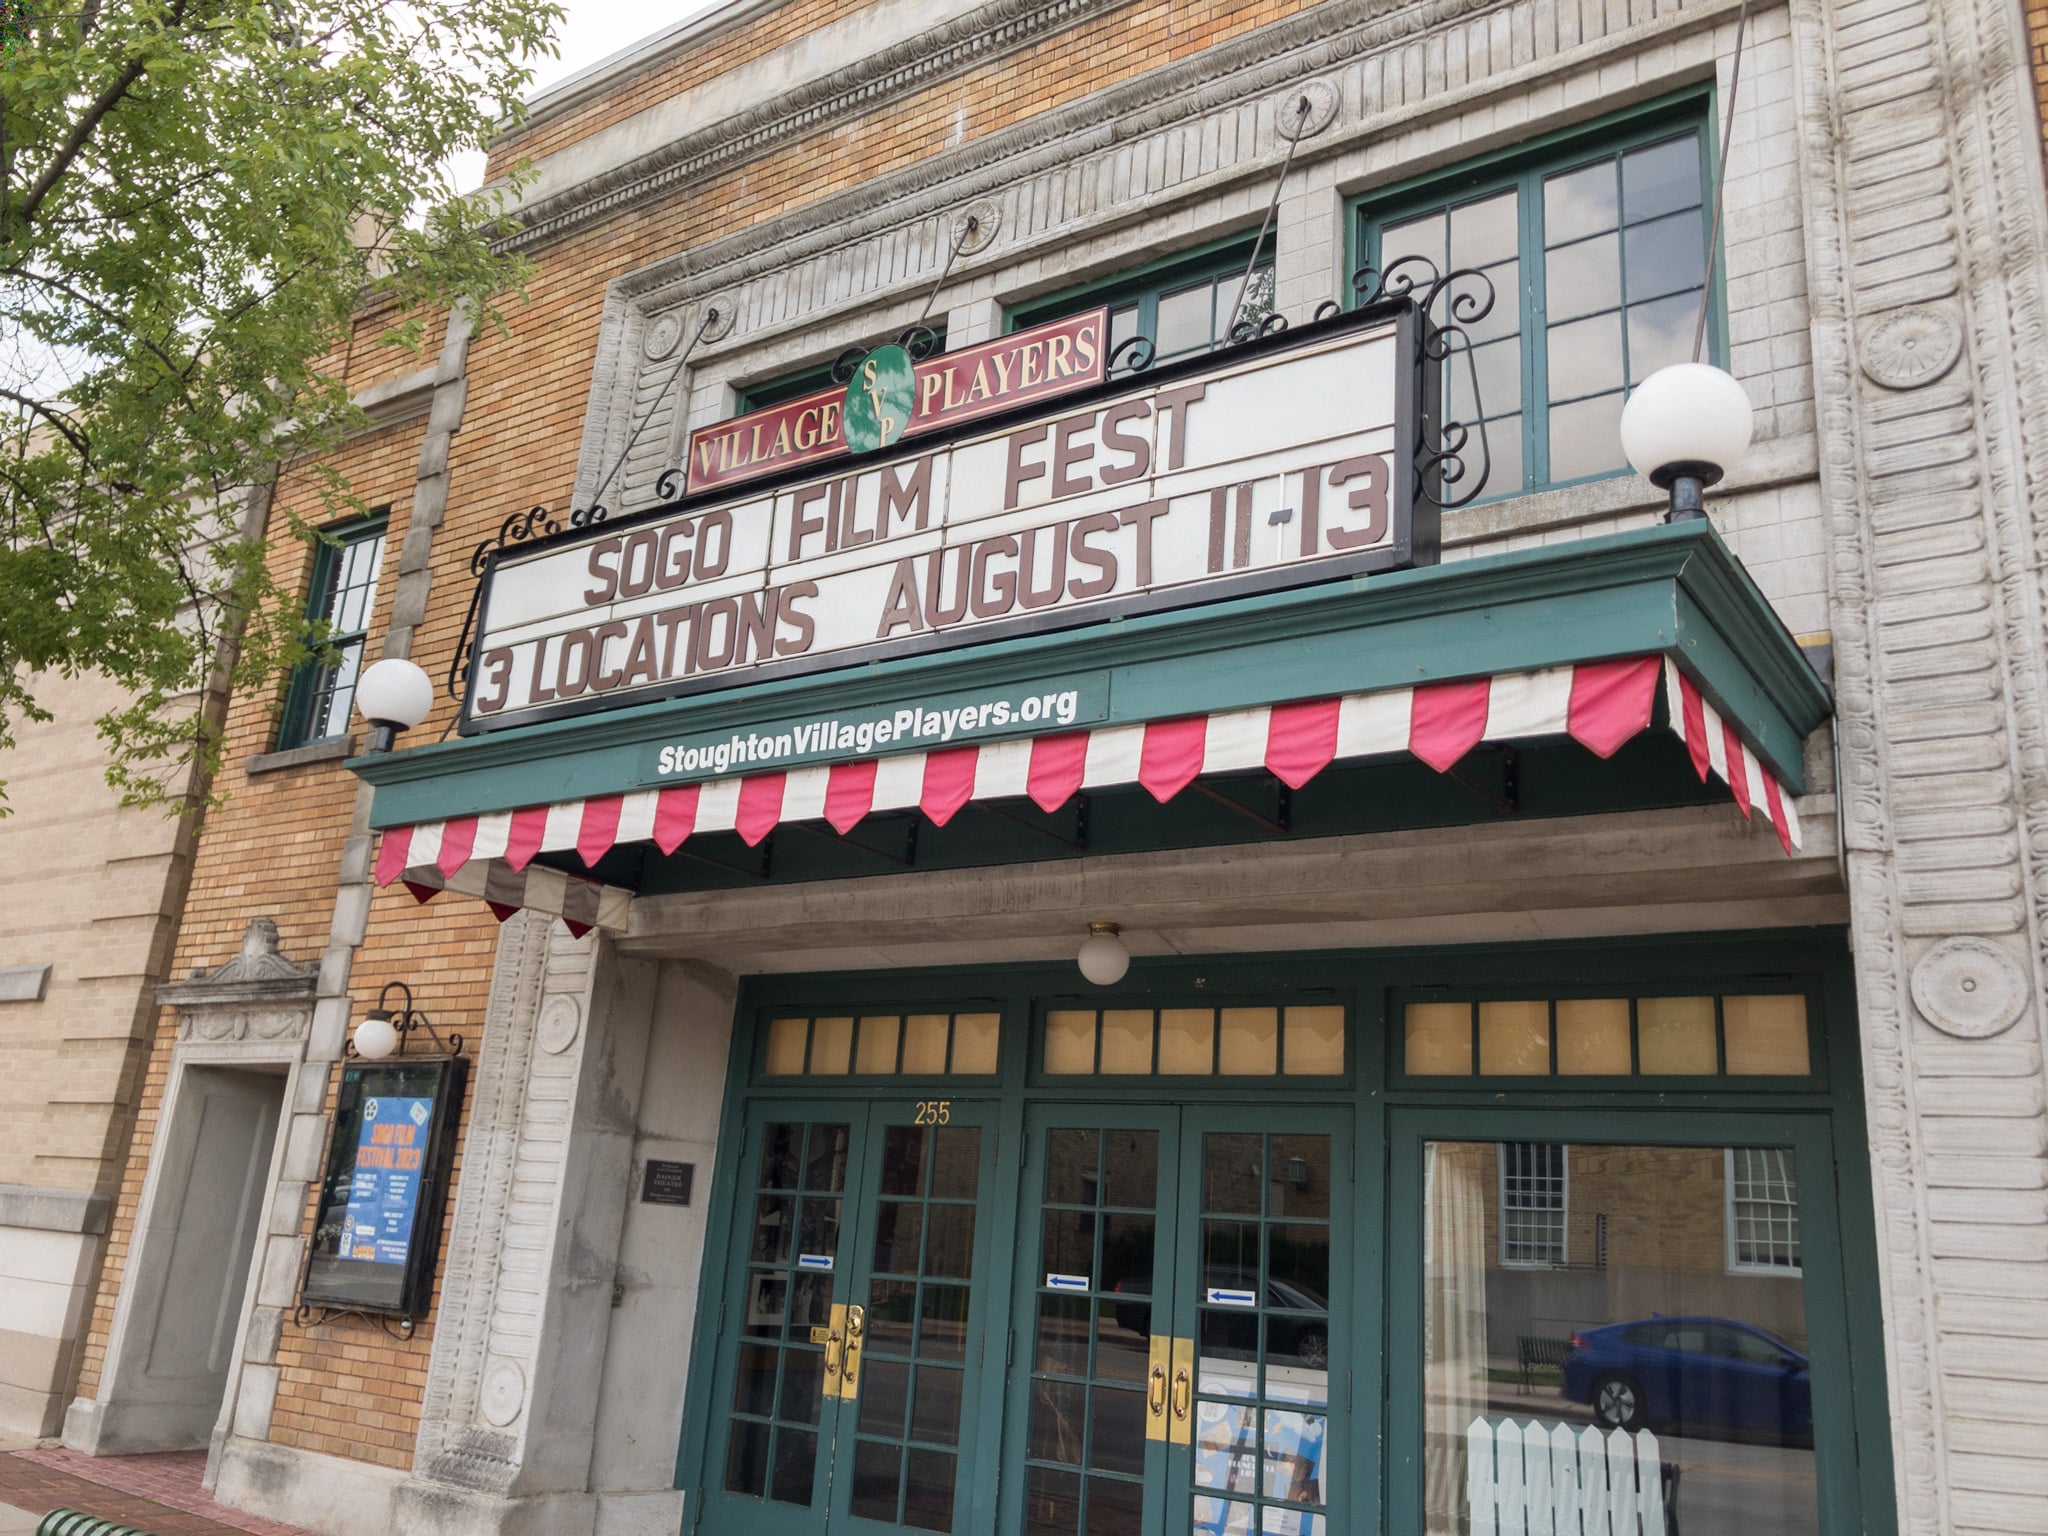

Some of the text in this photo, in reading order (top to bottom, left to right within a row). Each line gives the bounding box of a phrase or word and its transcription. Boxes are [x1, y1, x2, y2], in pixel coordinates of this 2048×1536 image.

[698, 325, 1097, 478] VILLAGE PLAYERS
[584, 384, 1206, 606] SOGO FILM FEST
[476, 454, 1389, 714] 3 LOCATIONS AUGUST 11-13
[657, 690, 1078, 776] StoughtonVillagePlayers.org
[356, 1146, 395, 1168] FESTIVAL
[914, 1101, 950, 1125] 255
